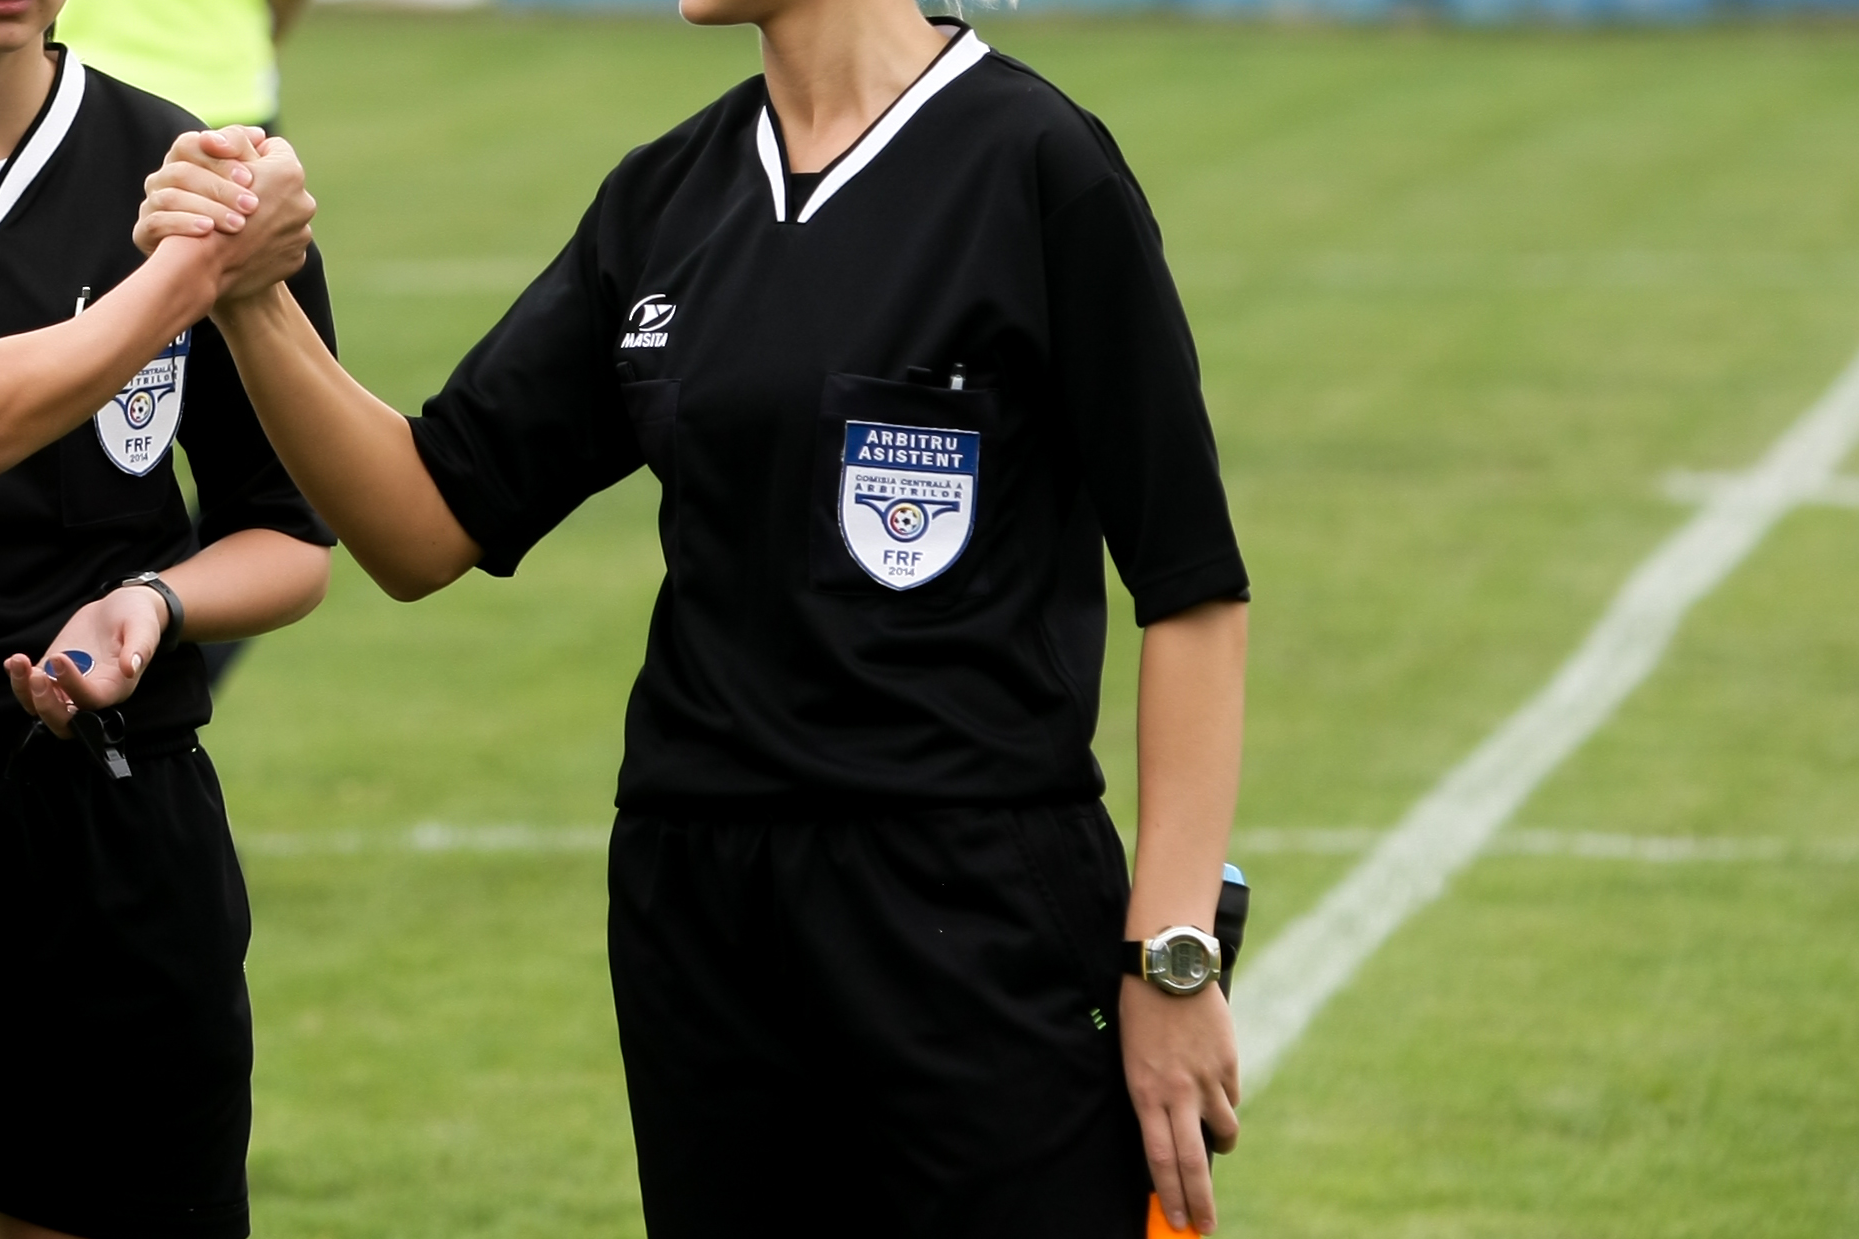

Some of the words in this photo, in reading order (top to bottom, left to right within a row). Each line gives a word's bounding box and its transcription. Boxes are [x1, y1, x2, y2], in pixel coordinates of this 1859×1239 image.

[621, 332, 669, 348] MASITA
[125, 436, 153, 453] FRF
[866, 429, 958, 450] ARBITRU
[130, 453, 149, 463] 2014
[858, 446, 963, 468] ASISTENT
[854, 482, 962, 499] ARBITRILOR
[855, 474, 897, 485] COMISIA
[956, 482, 963, 490] A
[883, 550, 923, 567] FRF
[888, 567, 916, 577] 2014
